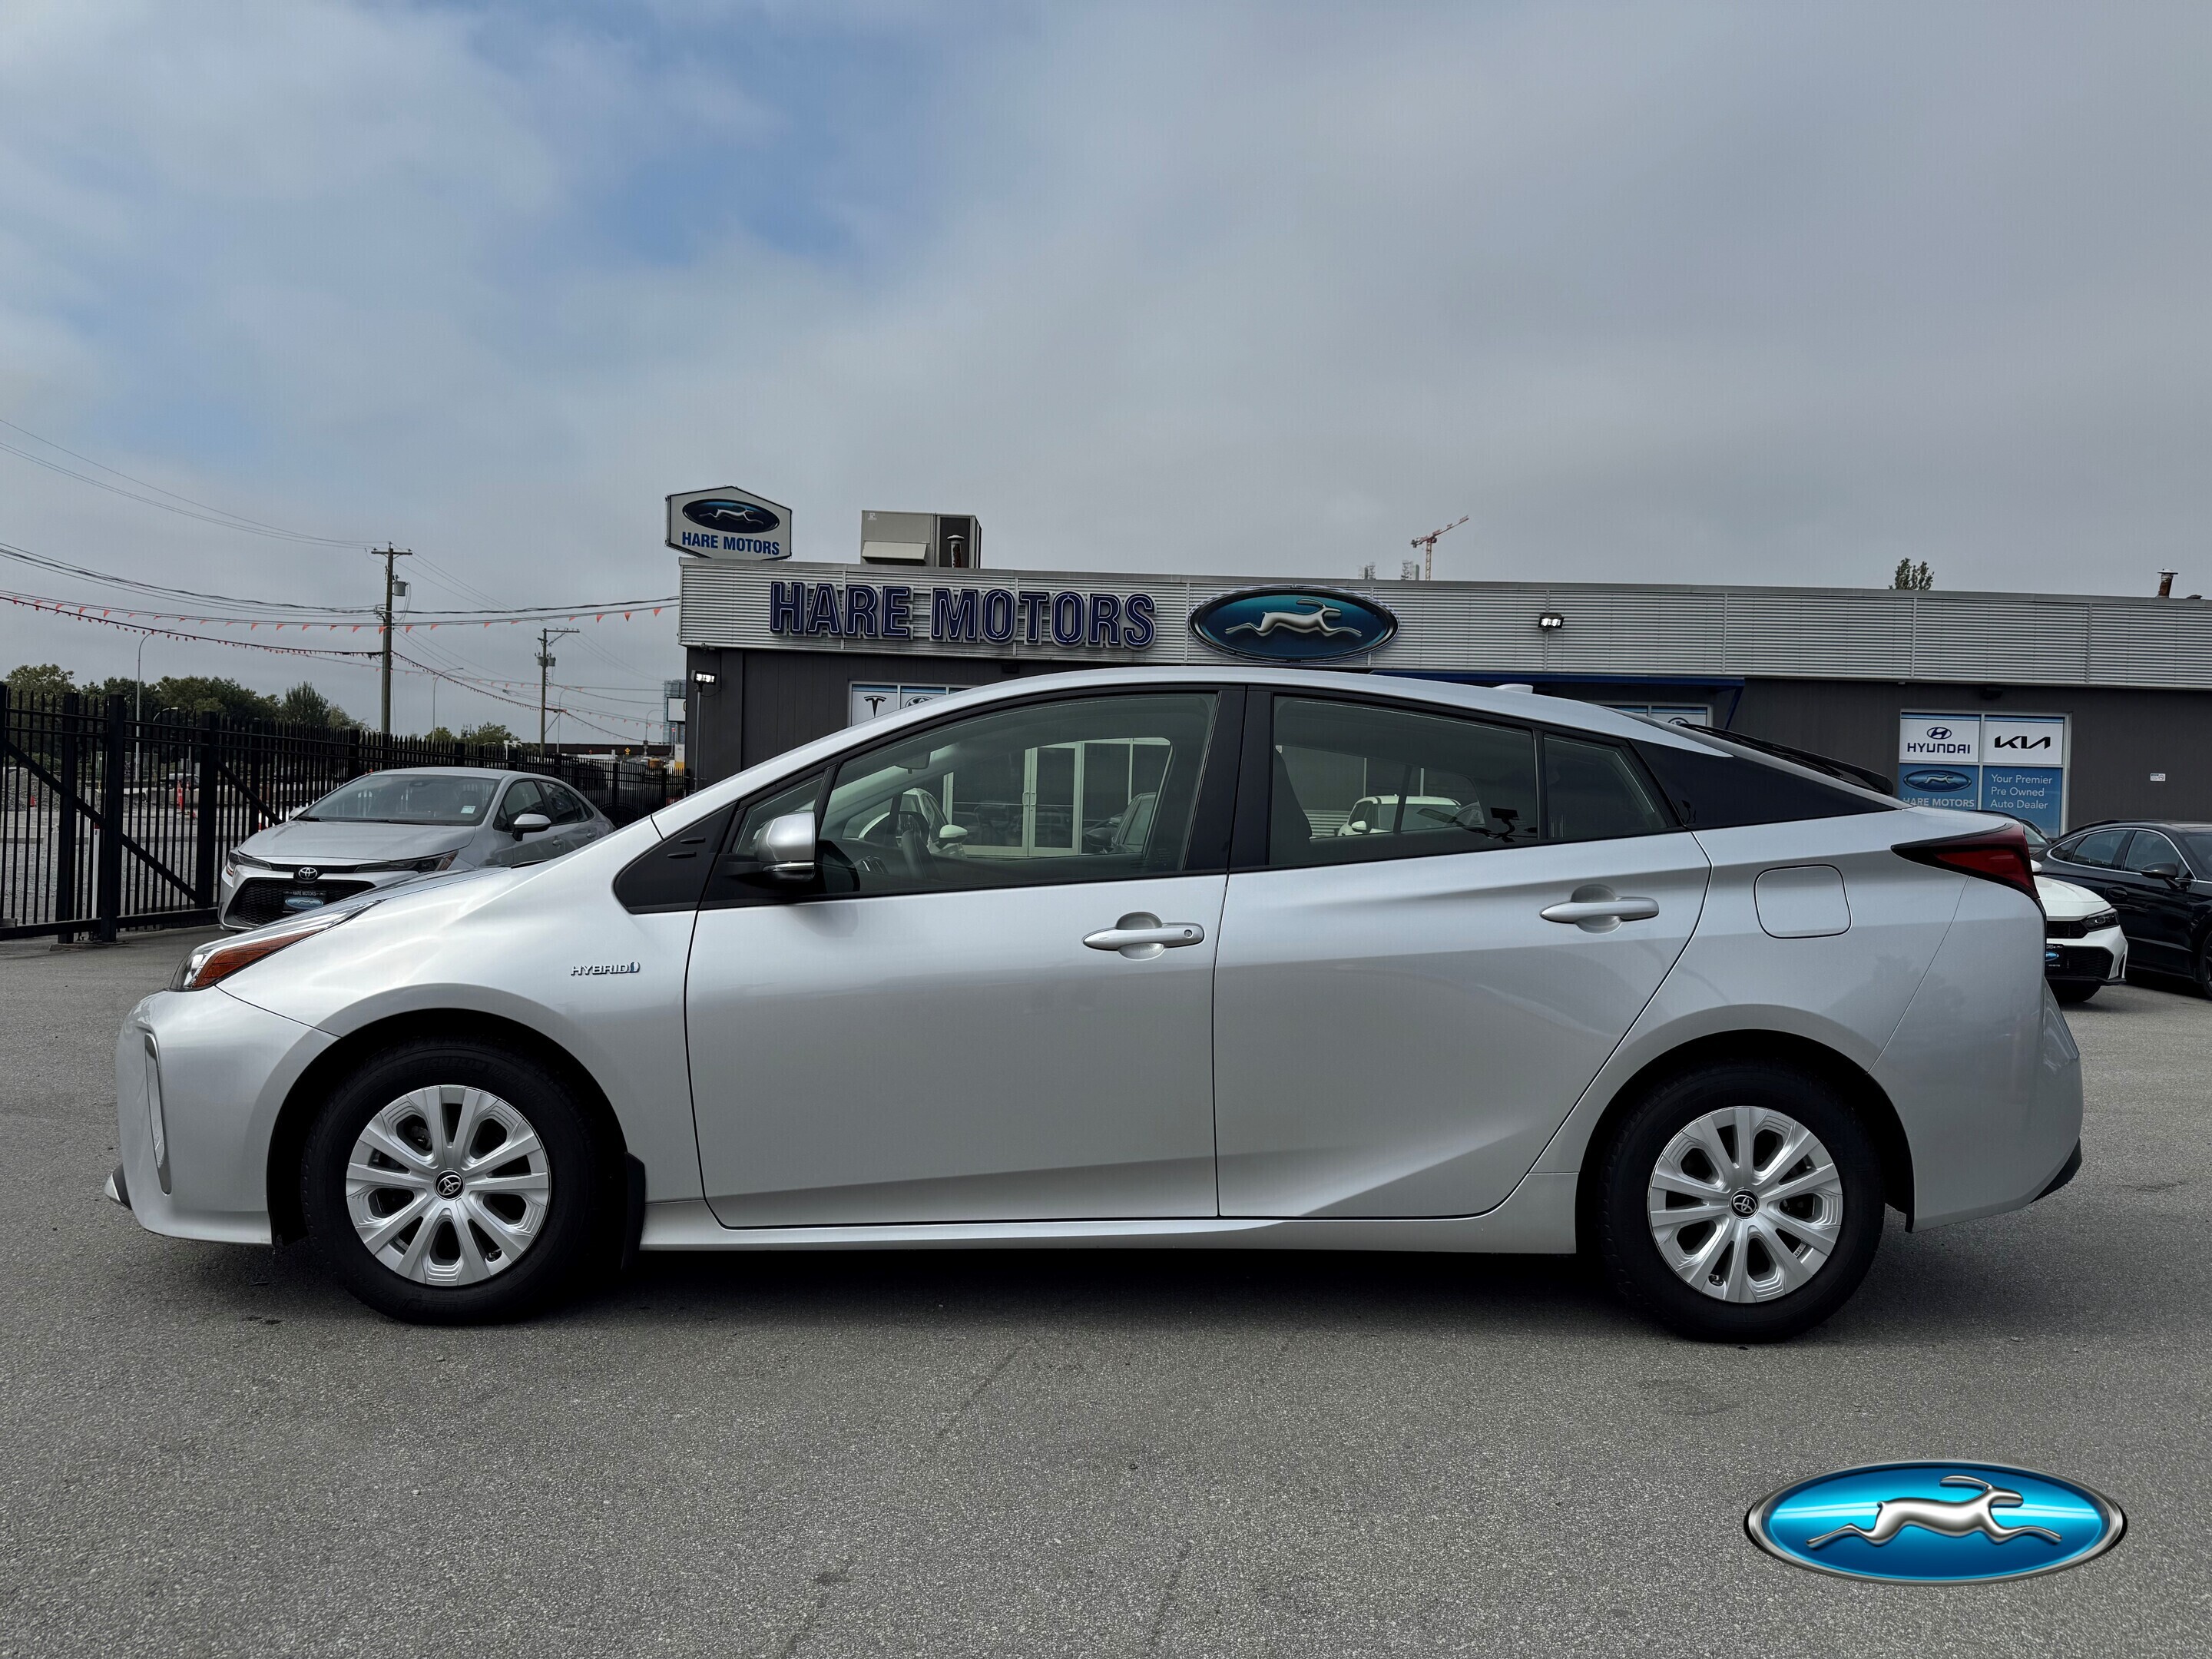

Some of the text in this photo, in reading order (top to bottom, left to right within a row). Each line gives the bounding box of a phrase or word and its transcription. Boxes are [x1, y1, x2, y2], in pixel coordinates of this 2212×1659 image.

[682, 531, 780, 555] HARE MOTORS
[770, 581, 1156, 649] HARE MOTORS
[1995, 735, 2051, 749] KIA
[1907, 743, 1970, 754] HYUNDAI
[1992, 774, 2052, 784] Your Premier
[1991, 786, 2045, 796] Pre Owned
[1932, 798, 1975, 807] MOTORS
[1990, 799, 2048, 810] Auto Dealer
[571, 964, 630, 976] HYBRID
